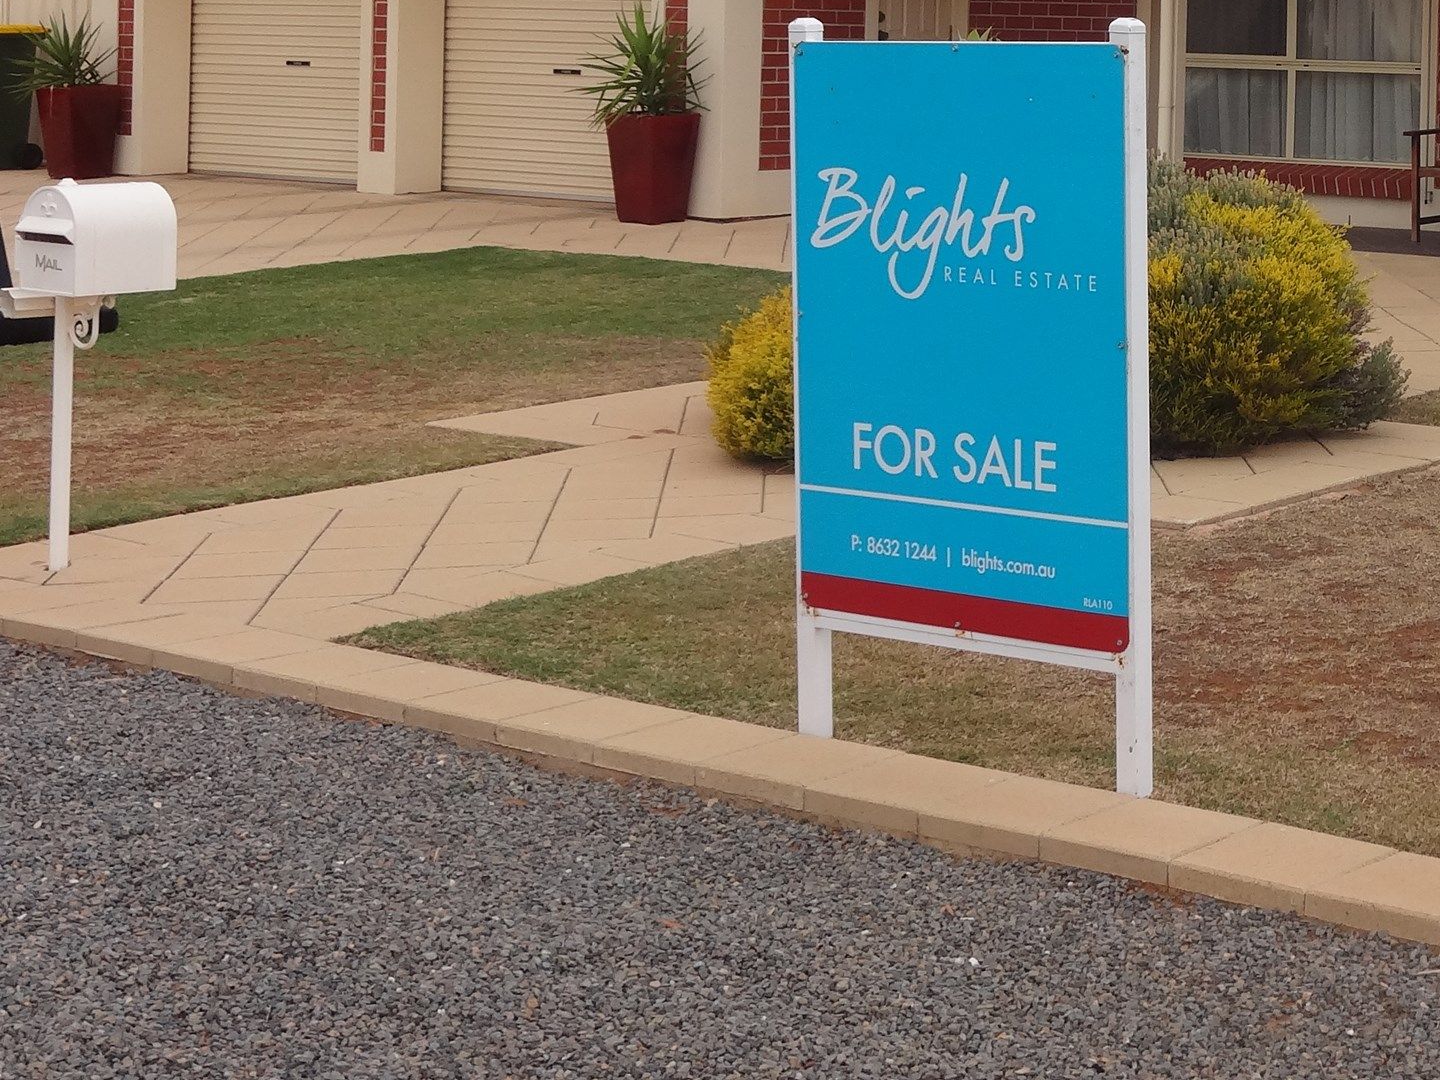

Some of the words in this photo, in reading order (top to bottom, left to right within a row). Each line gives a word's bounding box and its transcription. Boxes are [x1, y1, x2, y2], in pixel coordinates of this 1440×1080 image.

[810, 167, 1036, 300] Blights
[35, 253, 63, 272] MAIL
[943, 266, 997, 286] REAL
[1014, 271, 1097, 293] ESTATE
[852, 422, 939, 479] FOR
[952, 432, 1057, 493] SALE
[850, 534, 863, 552] P:
[866, 536, 900, 557] 8632
[903, 541, 937, 562] 1244
[961, 548, 1056, 579] blights.com.au
[1083, 597, 1113, 611] RLA110
